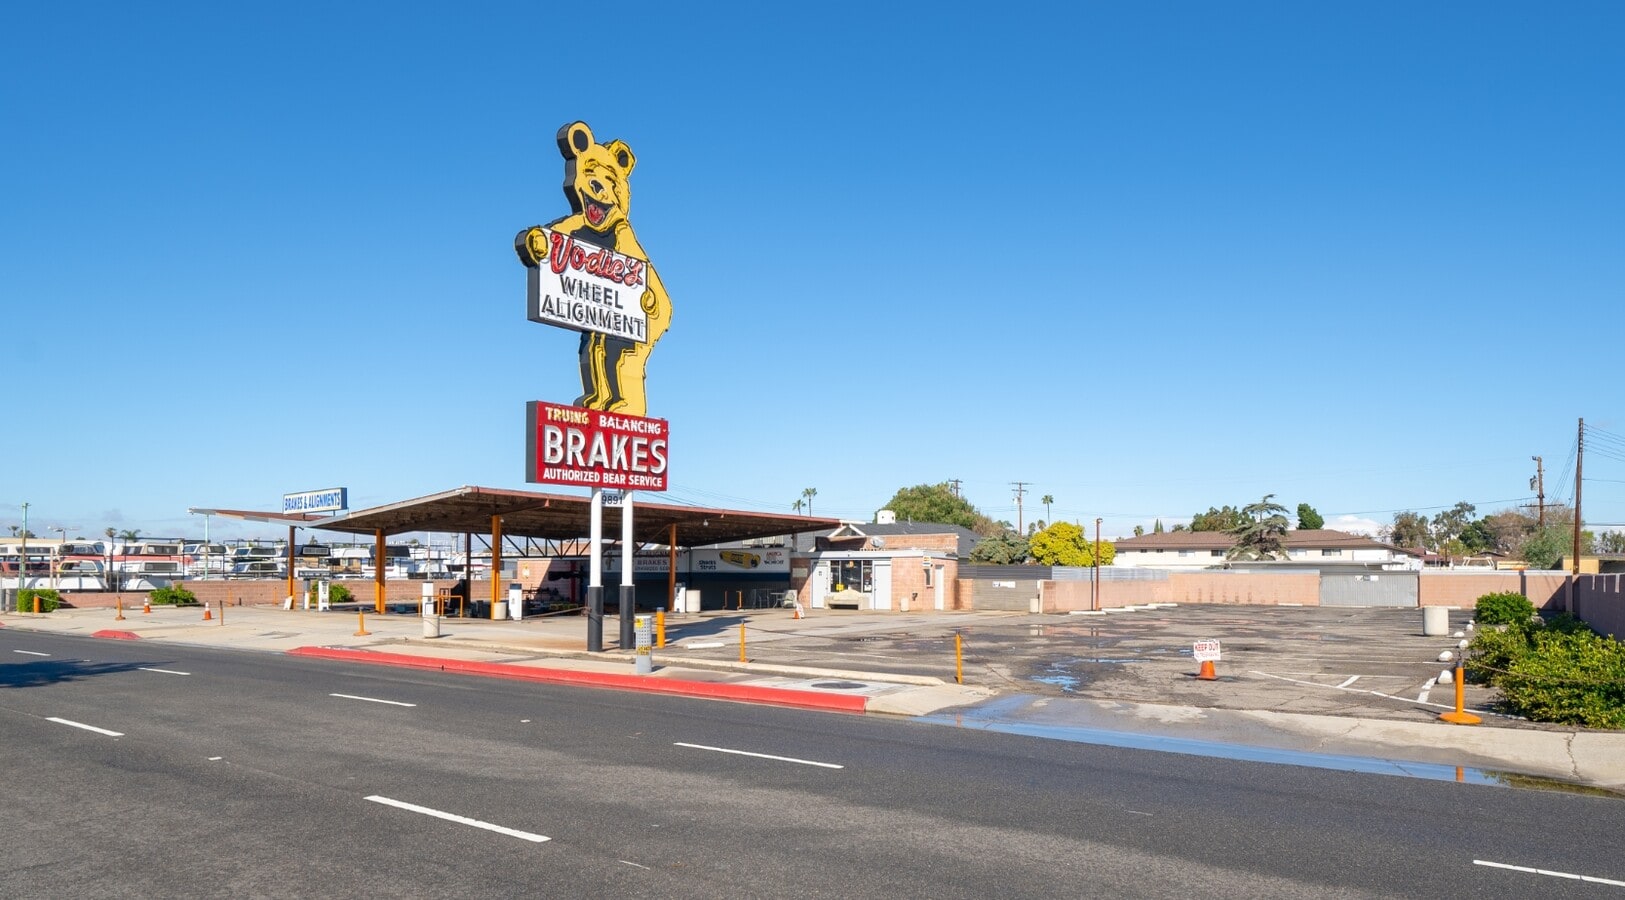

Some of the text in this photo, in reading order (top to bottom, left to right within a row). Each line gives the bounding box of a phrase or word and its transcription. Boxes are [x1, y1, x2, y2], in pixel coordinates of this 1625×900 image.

[560, 274, 623, 309] WHEEL
[541, 294, 644, 337] ALIGNMENT
[545, 407, 661, 434] TRUING BALANCING
[544, 425, 667, 474] BRAKES
[543, 468, 662, 487] AUTHORIZED BEAR SERVICE
[285, 492, 340, 511] BRAKES & ALIGNMENTS
